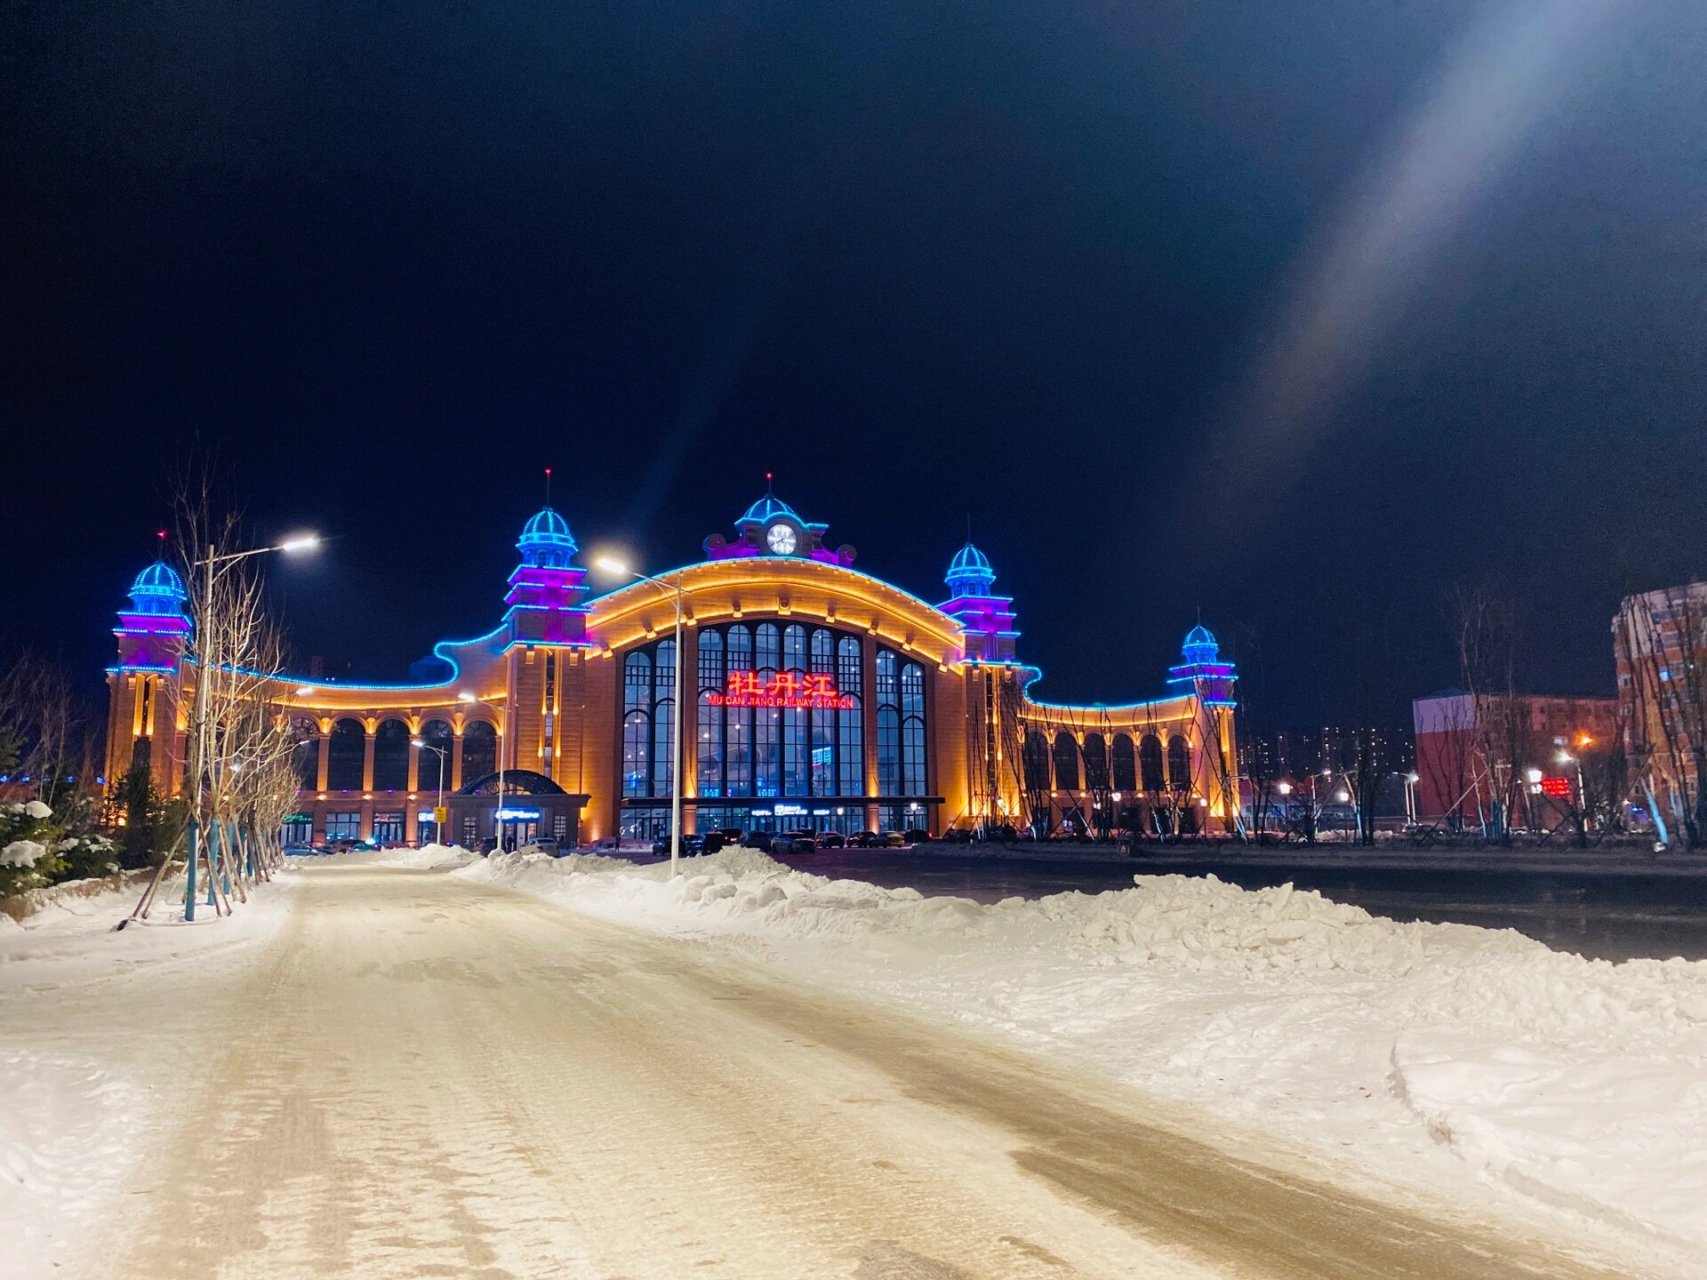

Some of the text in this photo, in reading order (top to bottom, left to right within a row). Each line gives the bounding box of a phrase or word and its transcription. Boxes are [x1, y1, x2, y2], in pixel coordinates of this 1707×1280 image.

[728, 671, 837, 697] 牡丹江
[709, 696, 854, 708] MU DAN JIANG RAILWAY STATION
